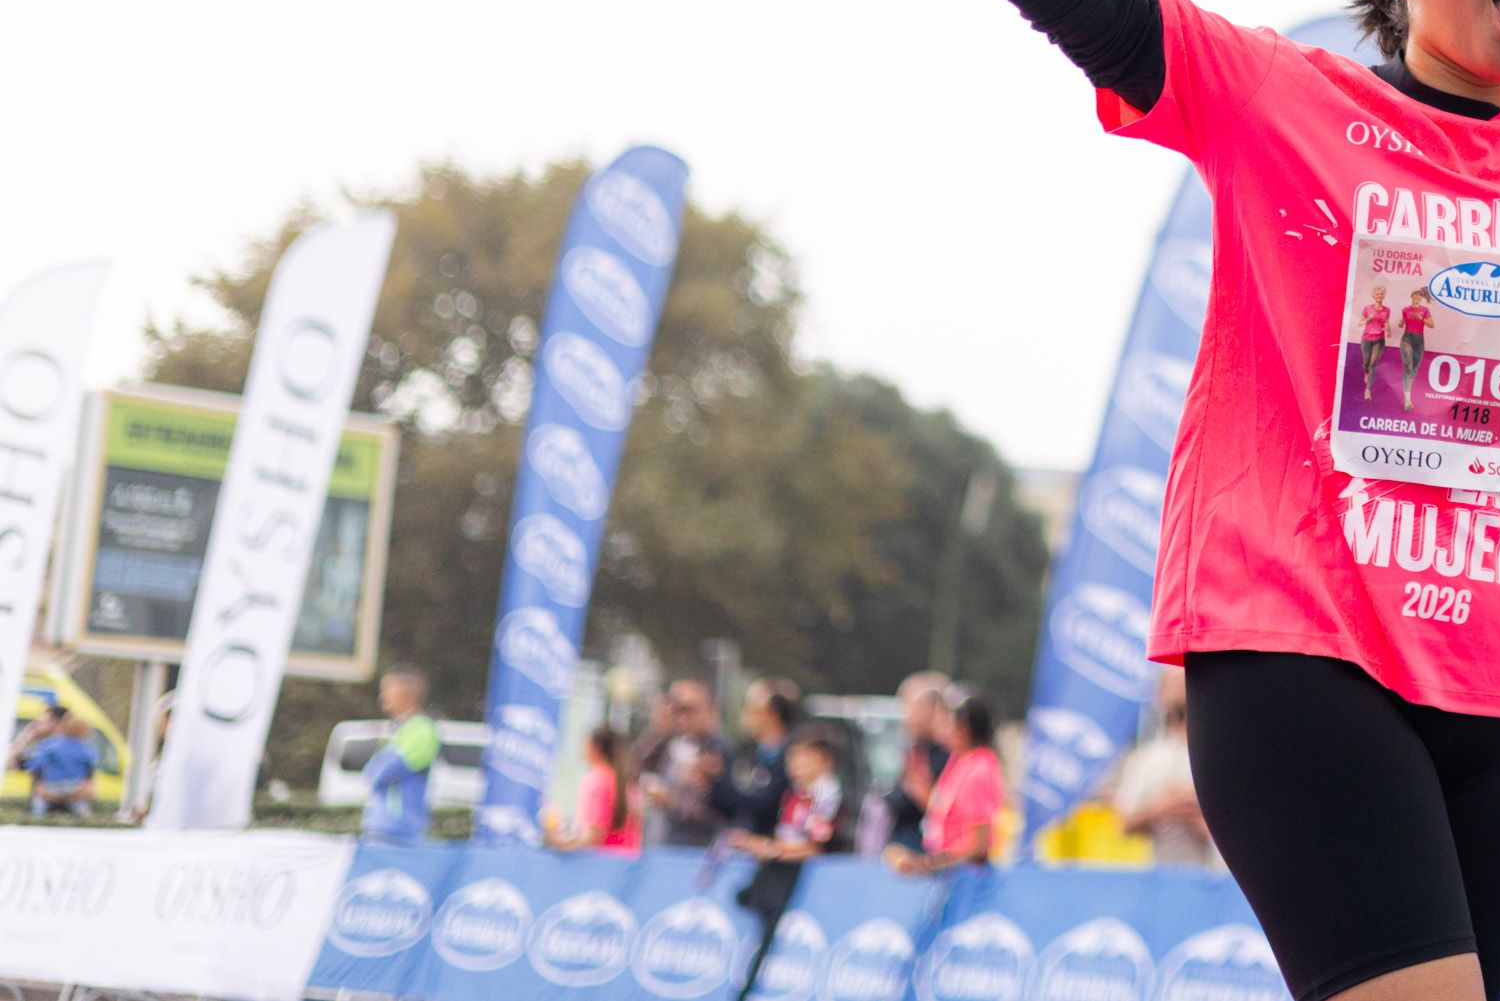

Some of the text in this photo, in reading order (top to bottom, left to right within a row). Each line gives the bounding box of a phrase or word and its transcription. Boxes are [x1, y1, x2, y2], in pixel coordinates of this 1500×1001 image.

[1372, 258, 1424, 276] SUMA
[1386, 250, 1424, 262] DORSAL
[1451, 403, 1490, 425] 1118
[1360, 416, 1416, 434] CARRERA
[1420, 422, 1437, 437] DE
[1440, 424, 1453, 439] LA
[1456, 427, 1493, 444] MUJER
[1361, 445, 1443, 470] OYSHO
[199, 316, 341, 728] OYSHO
[1402, 581, 1472, 625] 2026
